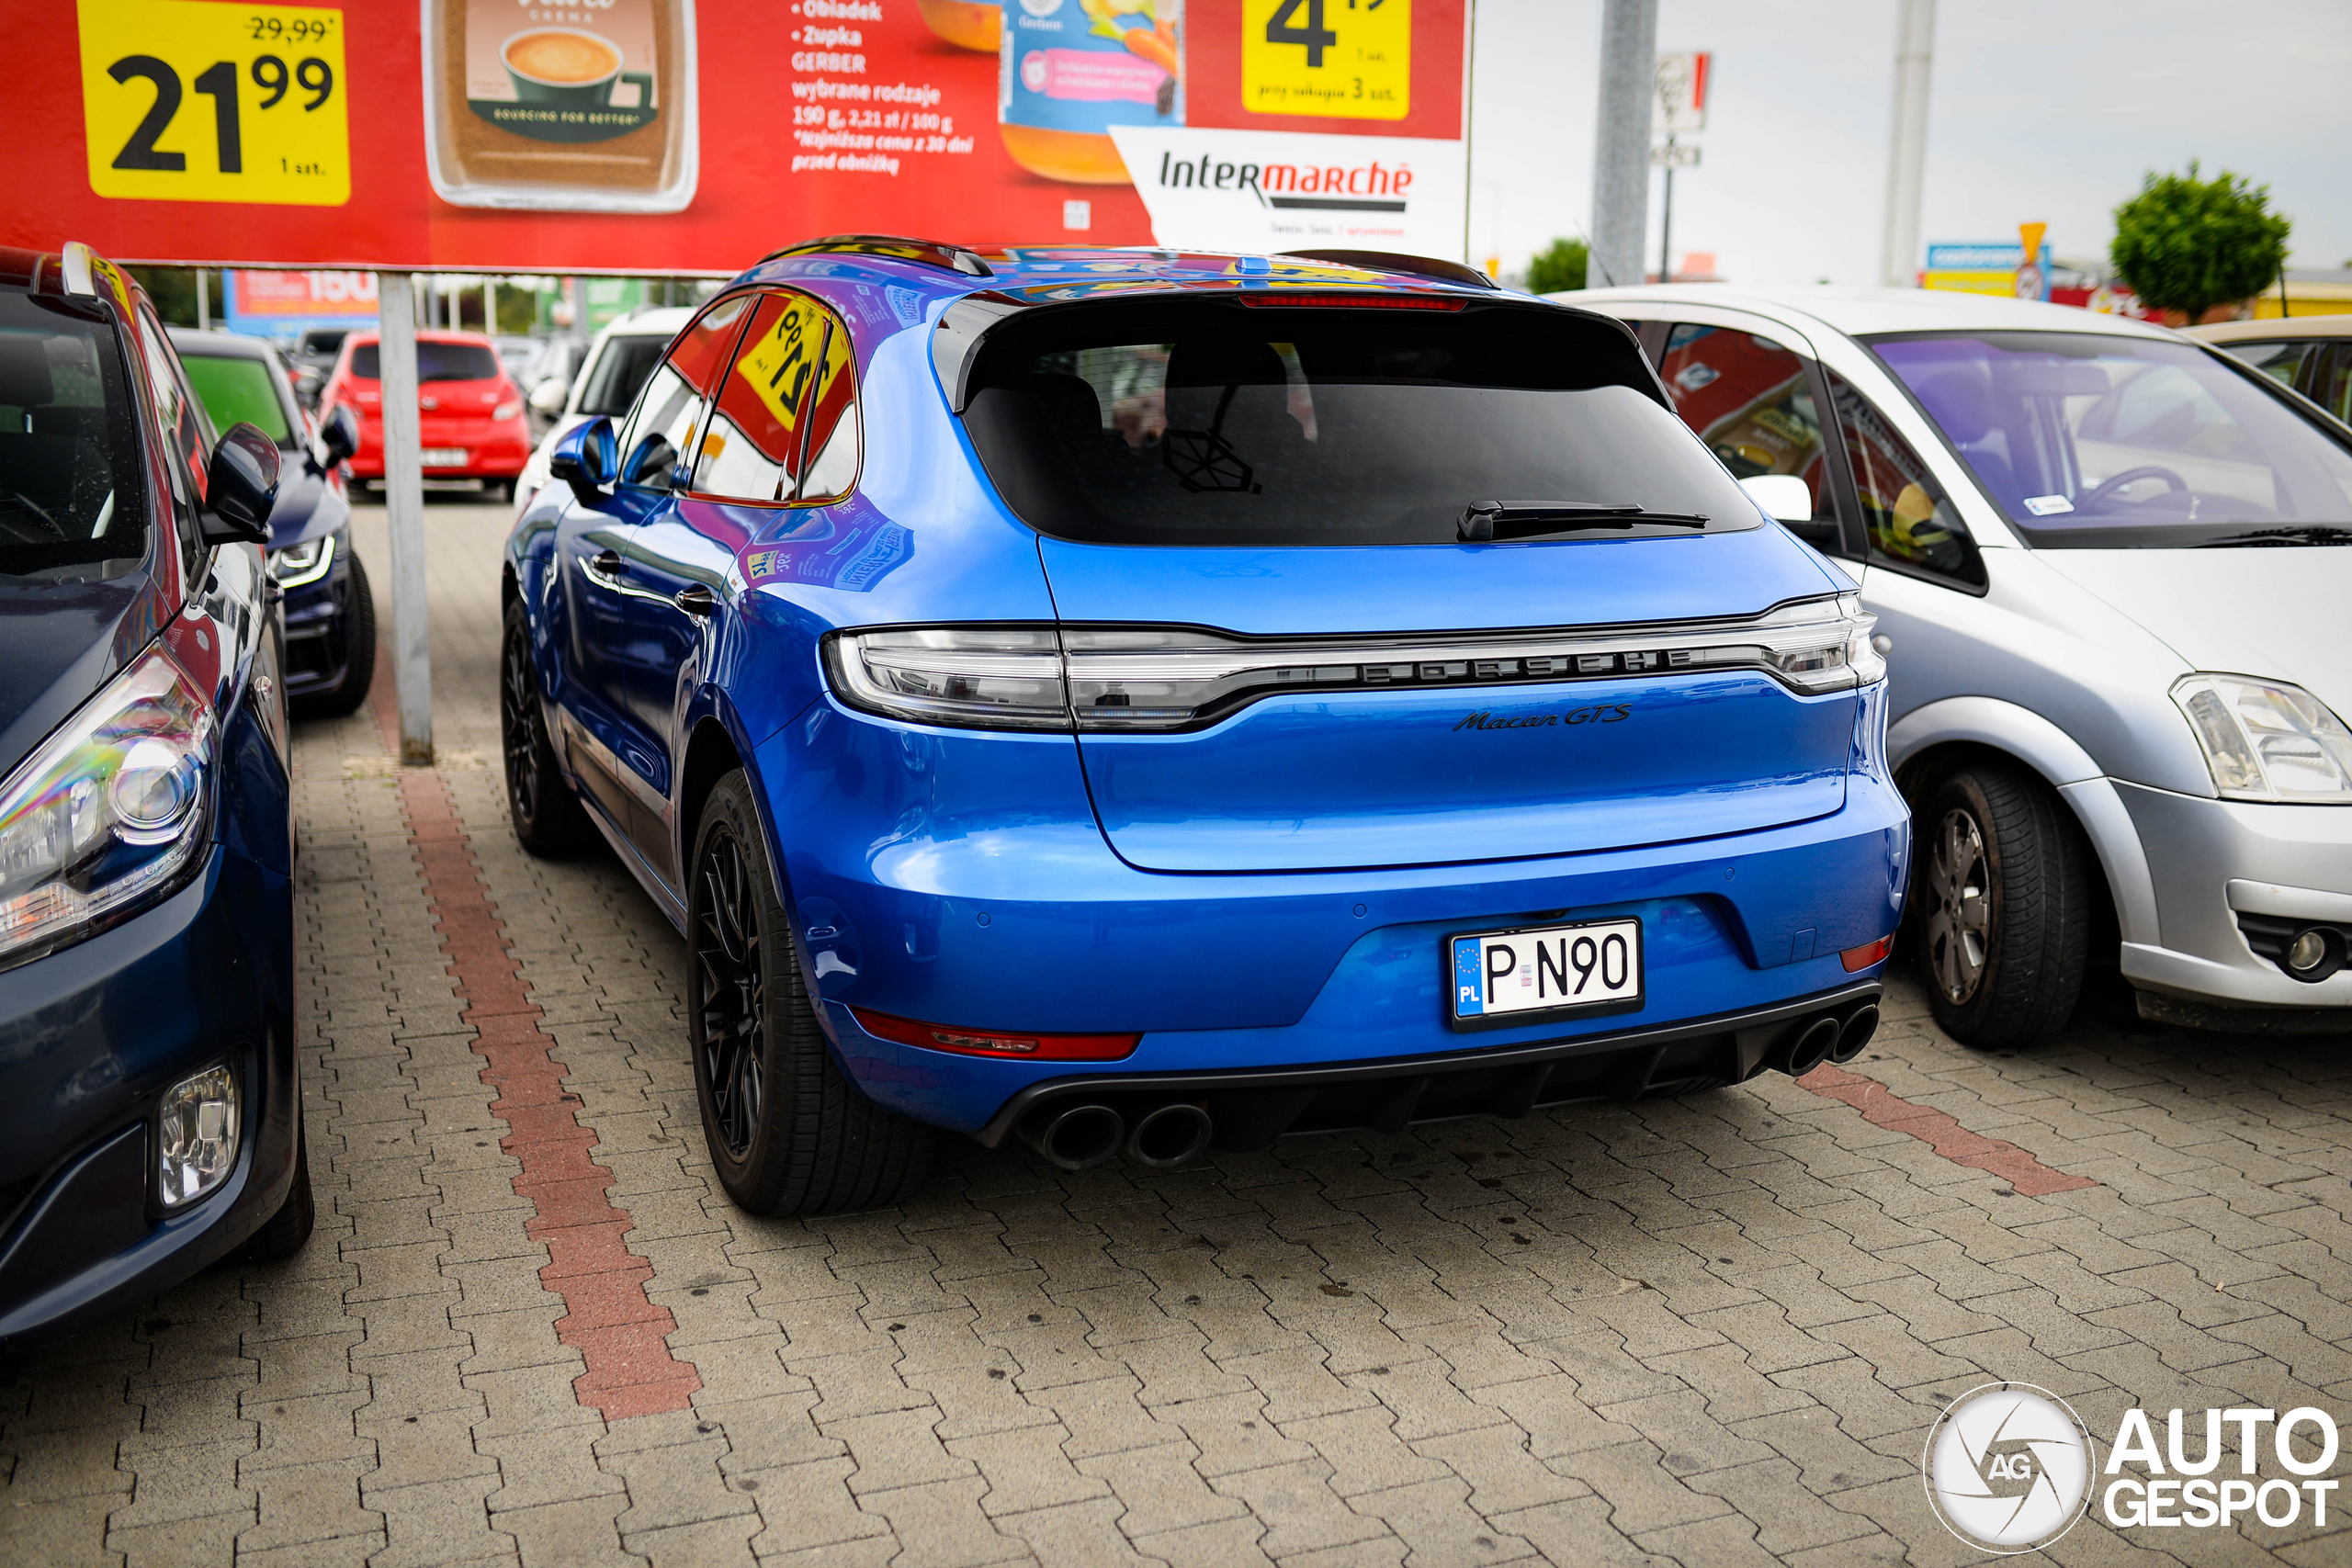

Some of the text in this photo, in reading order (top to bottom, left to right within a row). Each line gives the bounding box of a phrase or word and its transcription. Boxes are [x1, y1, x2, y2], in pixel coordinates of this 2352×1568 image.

[529, 9, 594, 23] CREMA
[802, 0, 882, 20] Obiadek
[803, 25, 863, 48] Zupka
[791, 51, 866, 73] GERBER
[791, 78, 941, 108] wybrane rodzaje
[1352, 77, 1363, 98] 3
[493, 108, 558, 123] SOURCING
[560, 111, 585, 124] FOR
[792, 106, 825, 125] 190
[941, 117, 954, 135] g
[876, 135, 914, 151] cena
[925, 135, 947, 153] 30
[947, 136, 974, 154] dni
[792, 152, 838, 173] przed
[1360, 649, 1692, 683] PORSCHE
[1453, 703, 1633, 732] Macan GTS
[1537, 933, 1628, 998] N90
[1460, 986, 1480, 1003] PL
